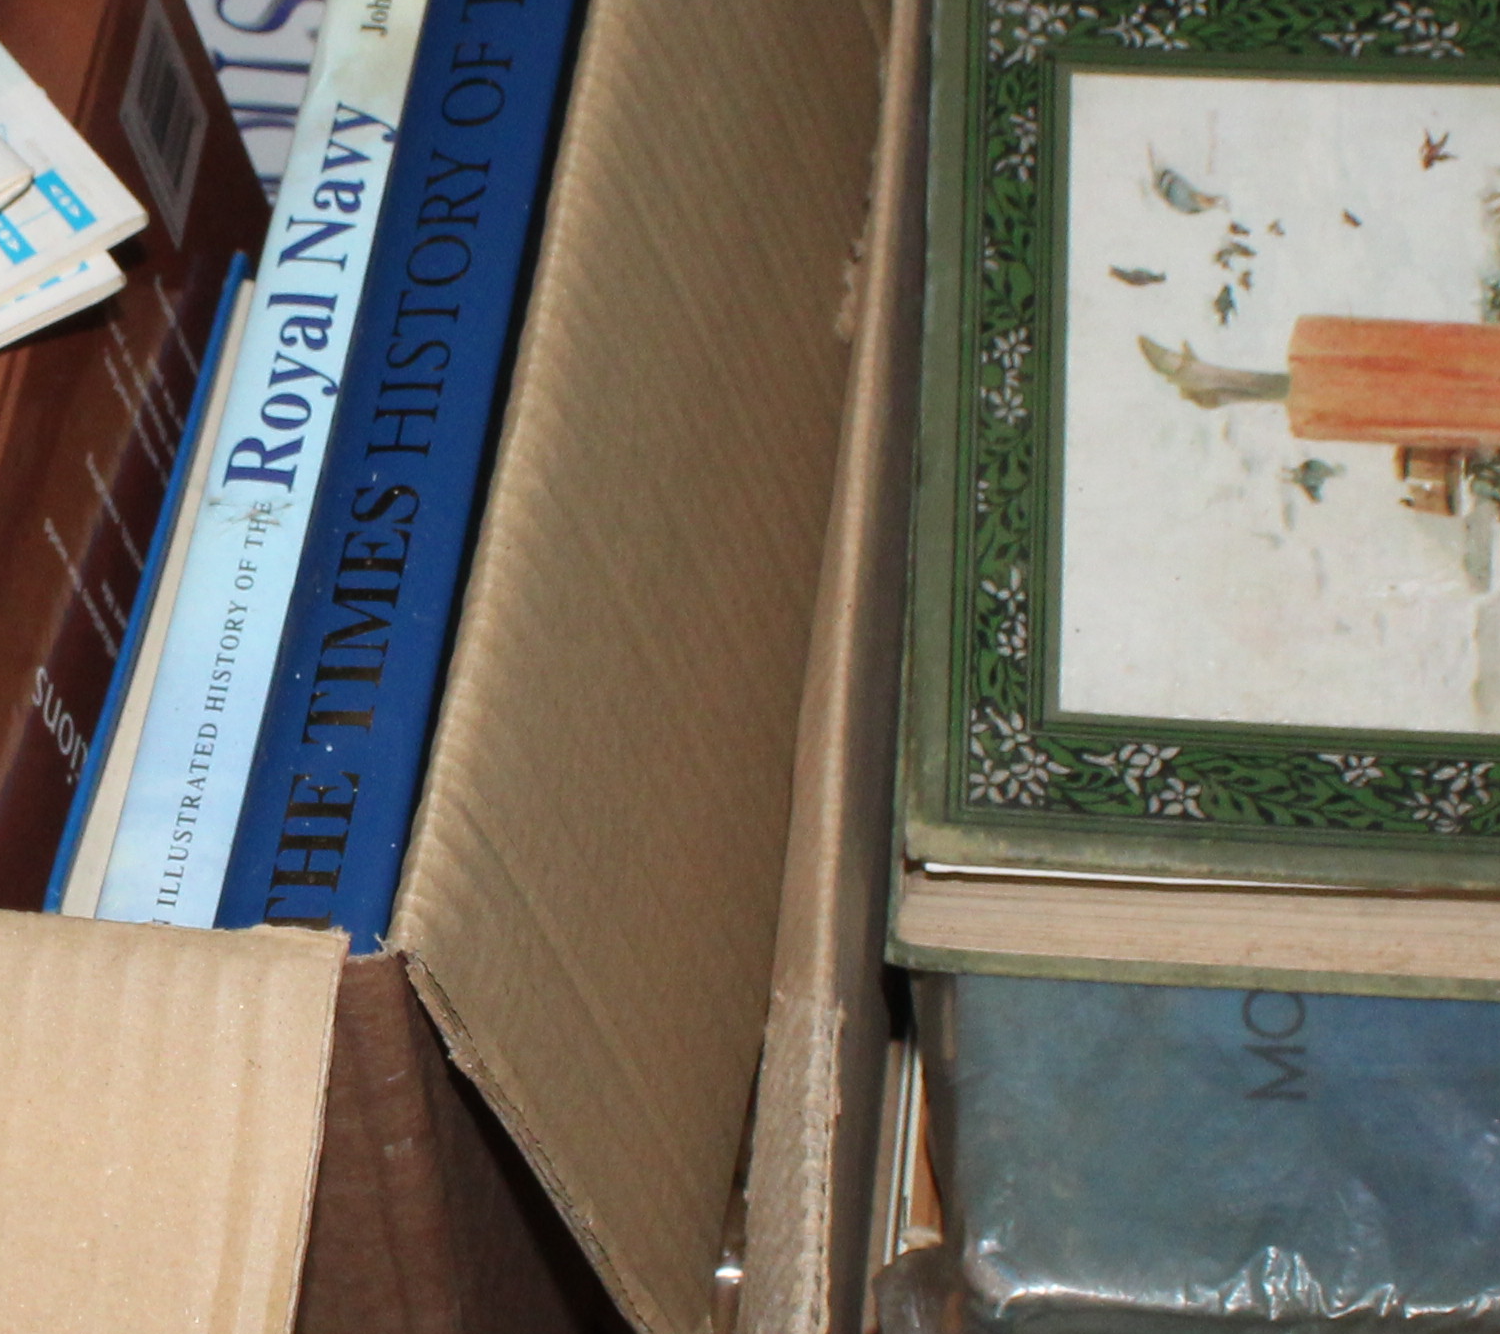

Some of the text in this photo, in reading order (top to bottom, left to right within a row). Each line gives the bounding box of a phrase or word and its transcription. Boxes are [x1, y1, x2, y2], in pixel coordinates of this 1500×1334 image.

[441, 41, 513, 128] OF
[223, 101, 399, 495] Royal Navy
[365, 151, 492, 459] HISTORY
[156, 721, 220, 908] ILLUSTRATED
[203, 600, 249, 714] HISTORY
[234, 559, 259, 592] OF
[302, 483, 421, 746] TIMES
[263, 770, 361, 931] THE
